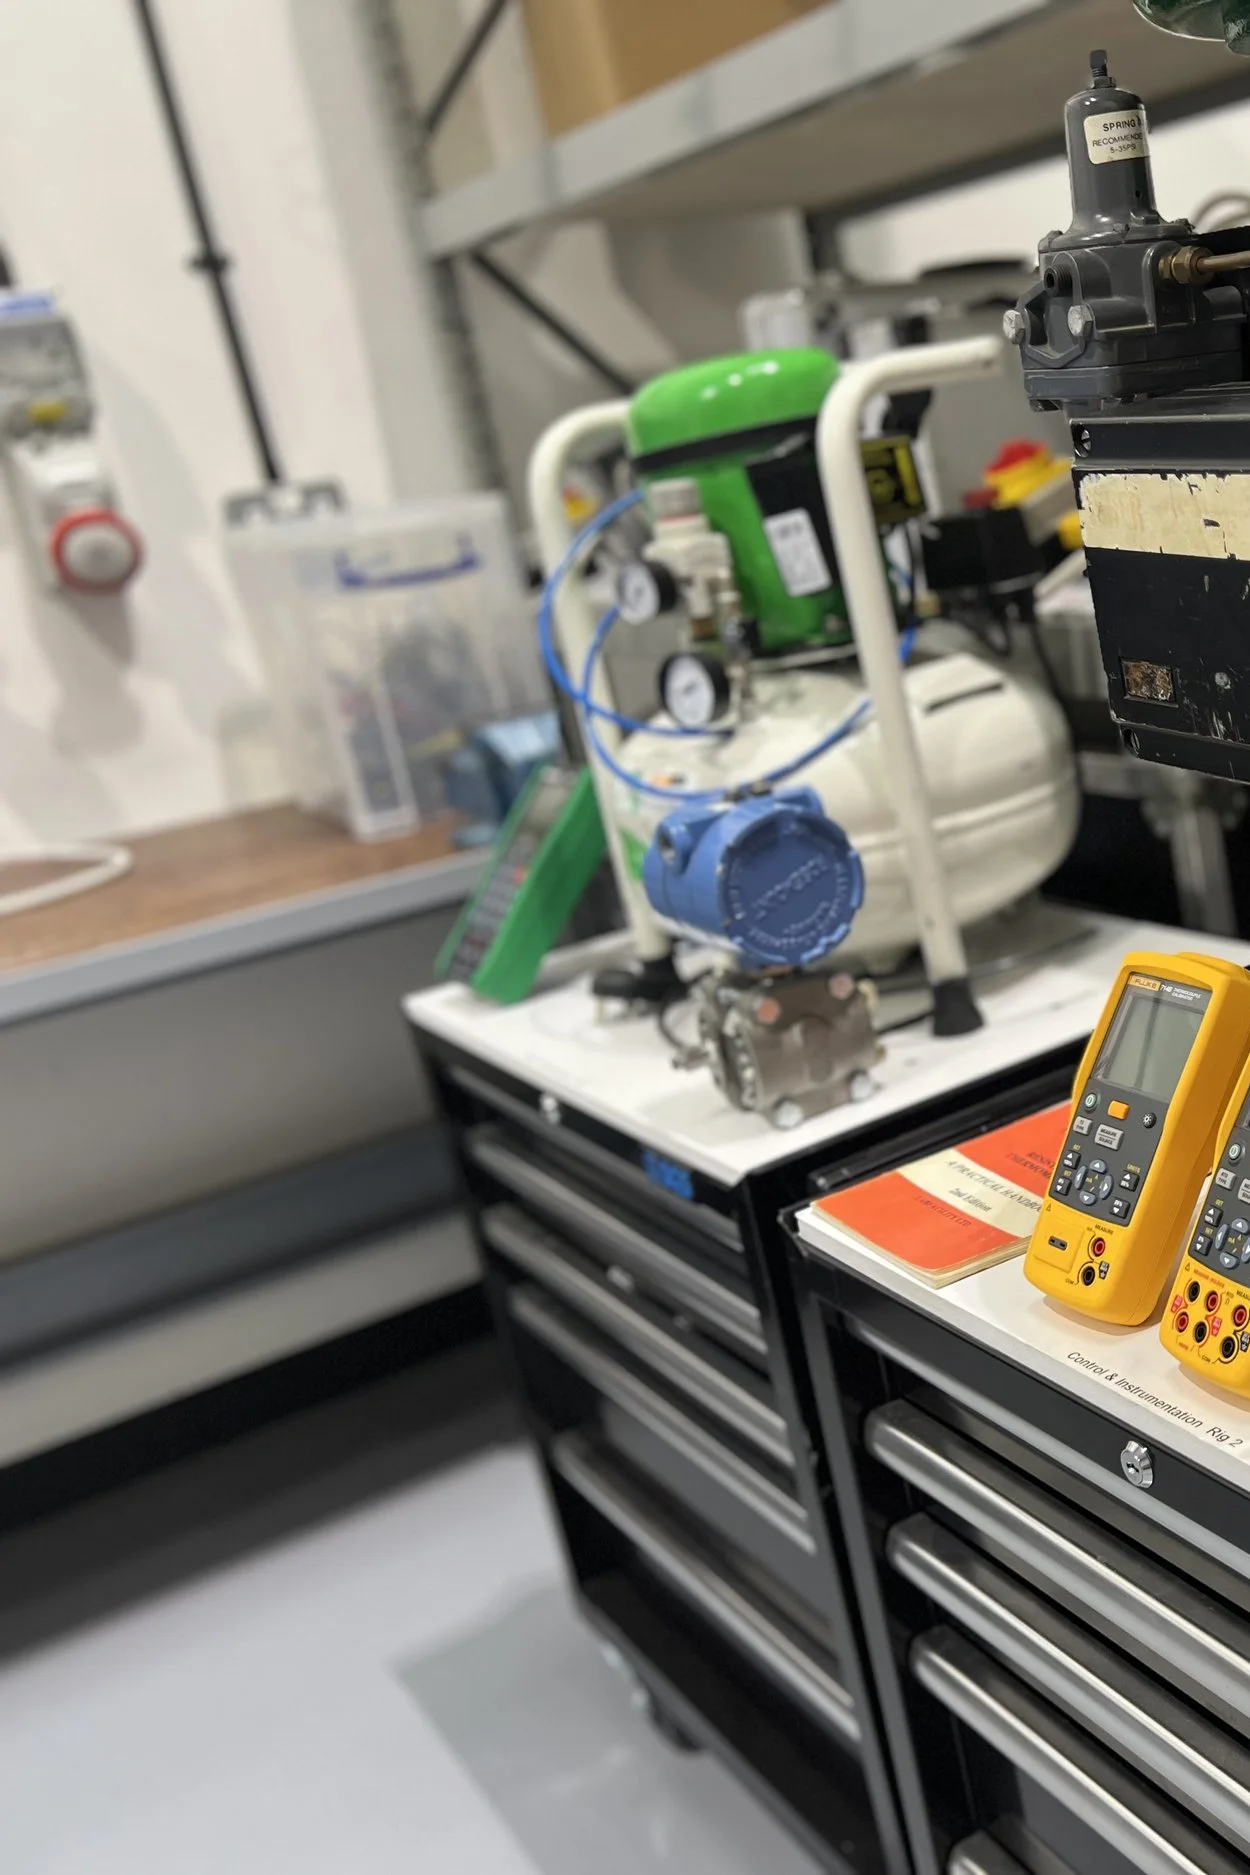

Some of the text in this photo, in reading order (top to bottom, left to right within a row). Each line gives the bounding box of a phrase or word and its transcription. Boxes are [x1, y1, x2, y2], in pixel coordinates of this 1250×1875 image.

[1102, 119, 1136, 132] SPRING
[1092, 132, 1144, 147] RECOMMENDE
[1134, 978, 1158, 990] FLUKE
[1094, 1223, 1114, 1236] MEASURE
[1067, 1351, 1244, 1448] Control & Instrumentation Rig 2
